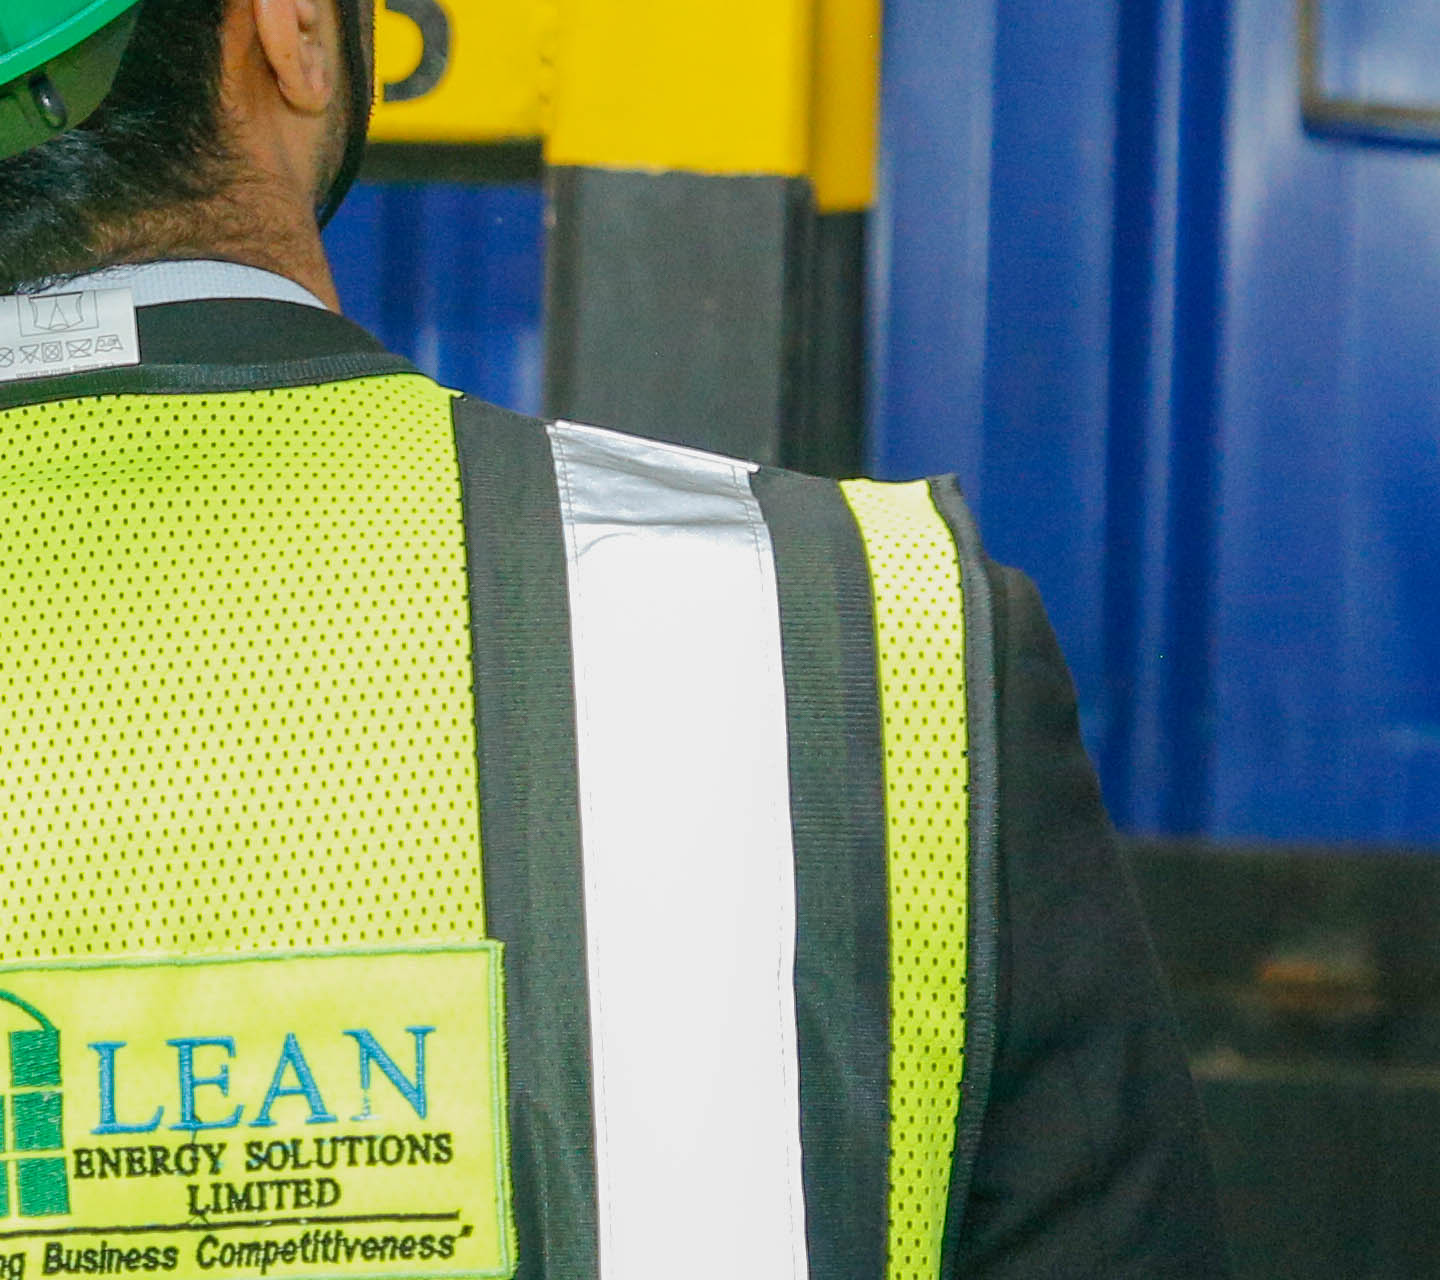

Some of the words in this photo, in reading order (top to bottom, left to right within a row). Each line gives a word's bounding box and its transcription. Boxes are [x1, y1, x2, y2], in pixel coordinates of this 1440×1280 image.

[87, 1025, 437, 1135] LEAN
[73, 1142, 228, 1180] ENERGY
[245, 1133, 454, 1172] SOLUTIONS
[187, 1177, 342, 1216] LIMITED
[41, 1240, 180, 1276] Business
